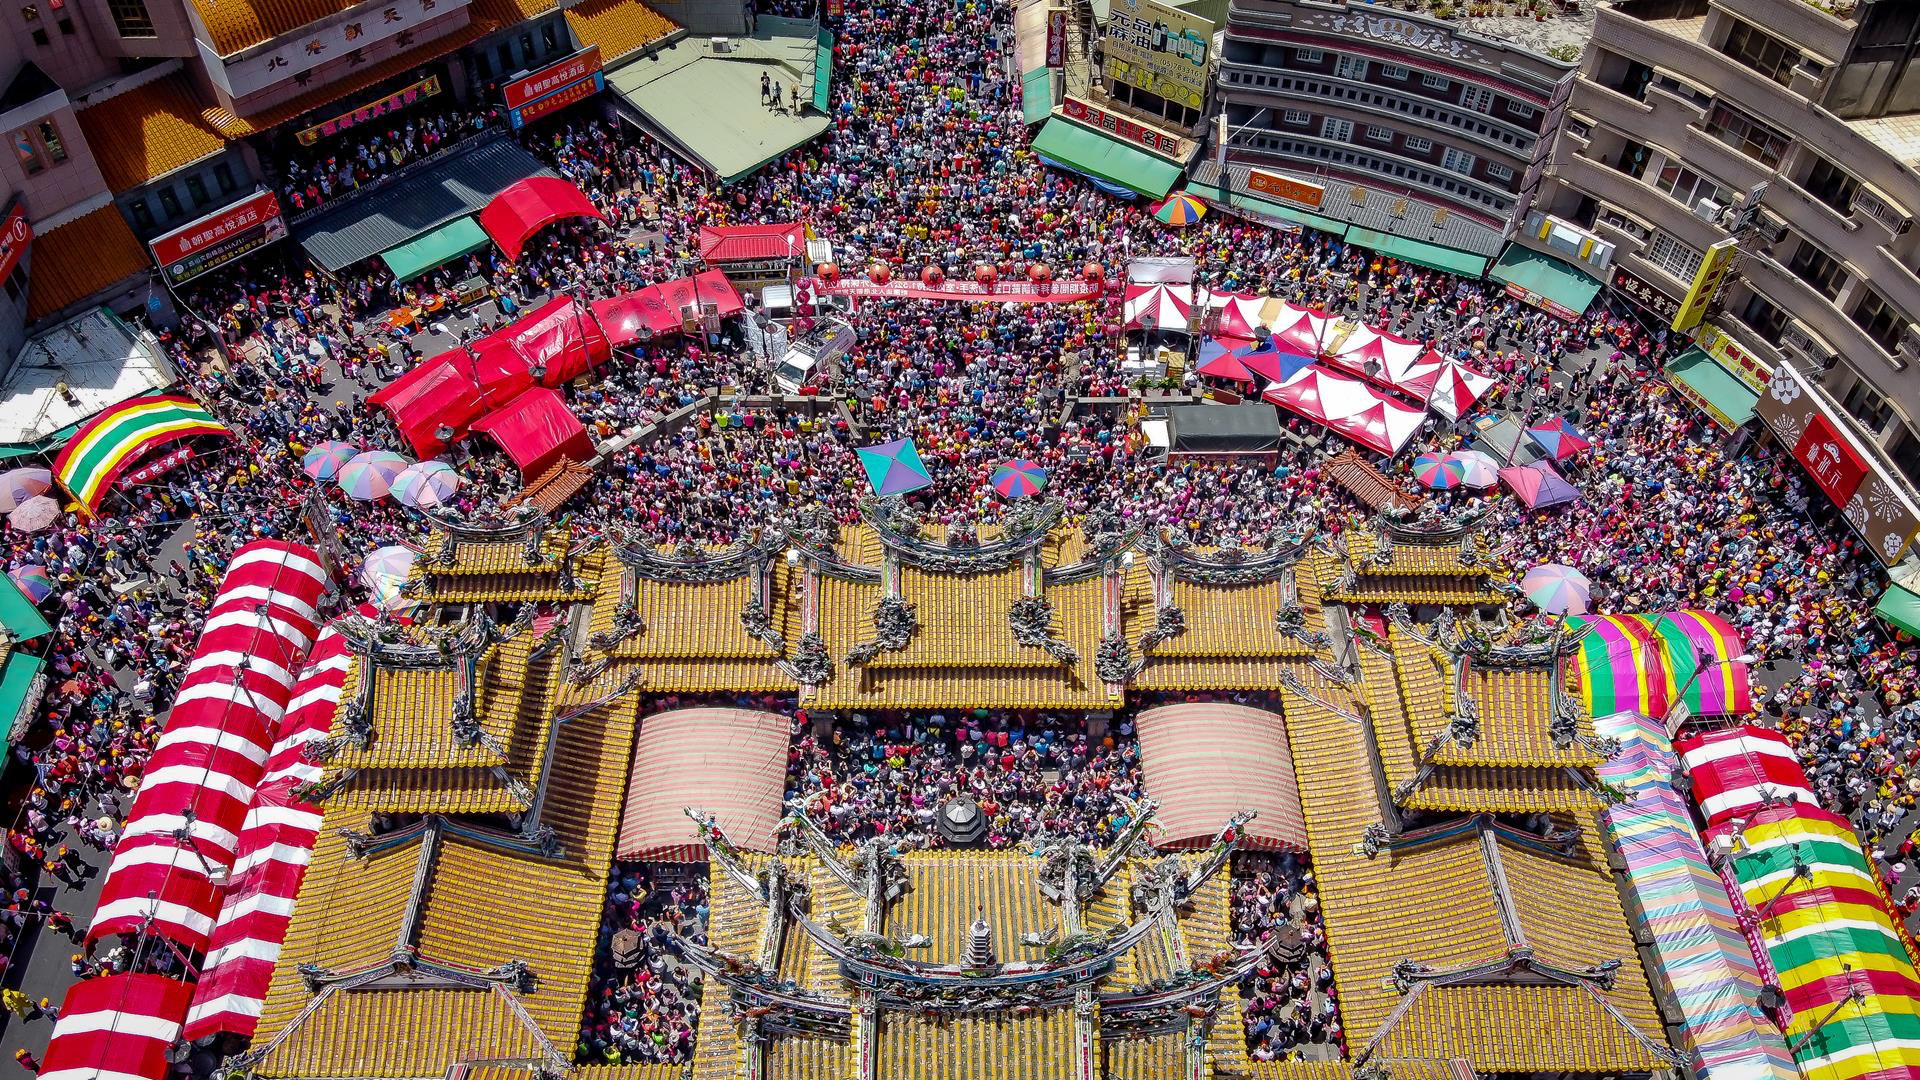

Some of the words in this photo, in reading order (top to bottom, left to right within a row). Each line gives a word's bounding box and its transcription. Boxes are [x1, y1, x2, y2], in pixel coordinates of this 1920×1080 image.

[1109, 24, 1150, 51] 麻油
[1110, 9, 1152, 36] 元品
[1086, 107, 1117, 132] 元品
[1142, 129, 1176, 154] 名店
[191, 210, 258, 247] 朝聖高悅酒店
